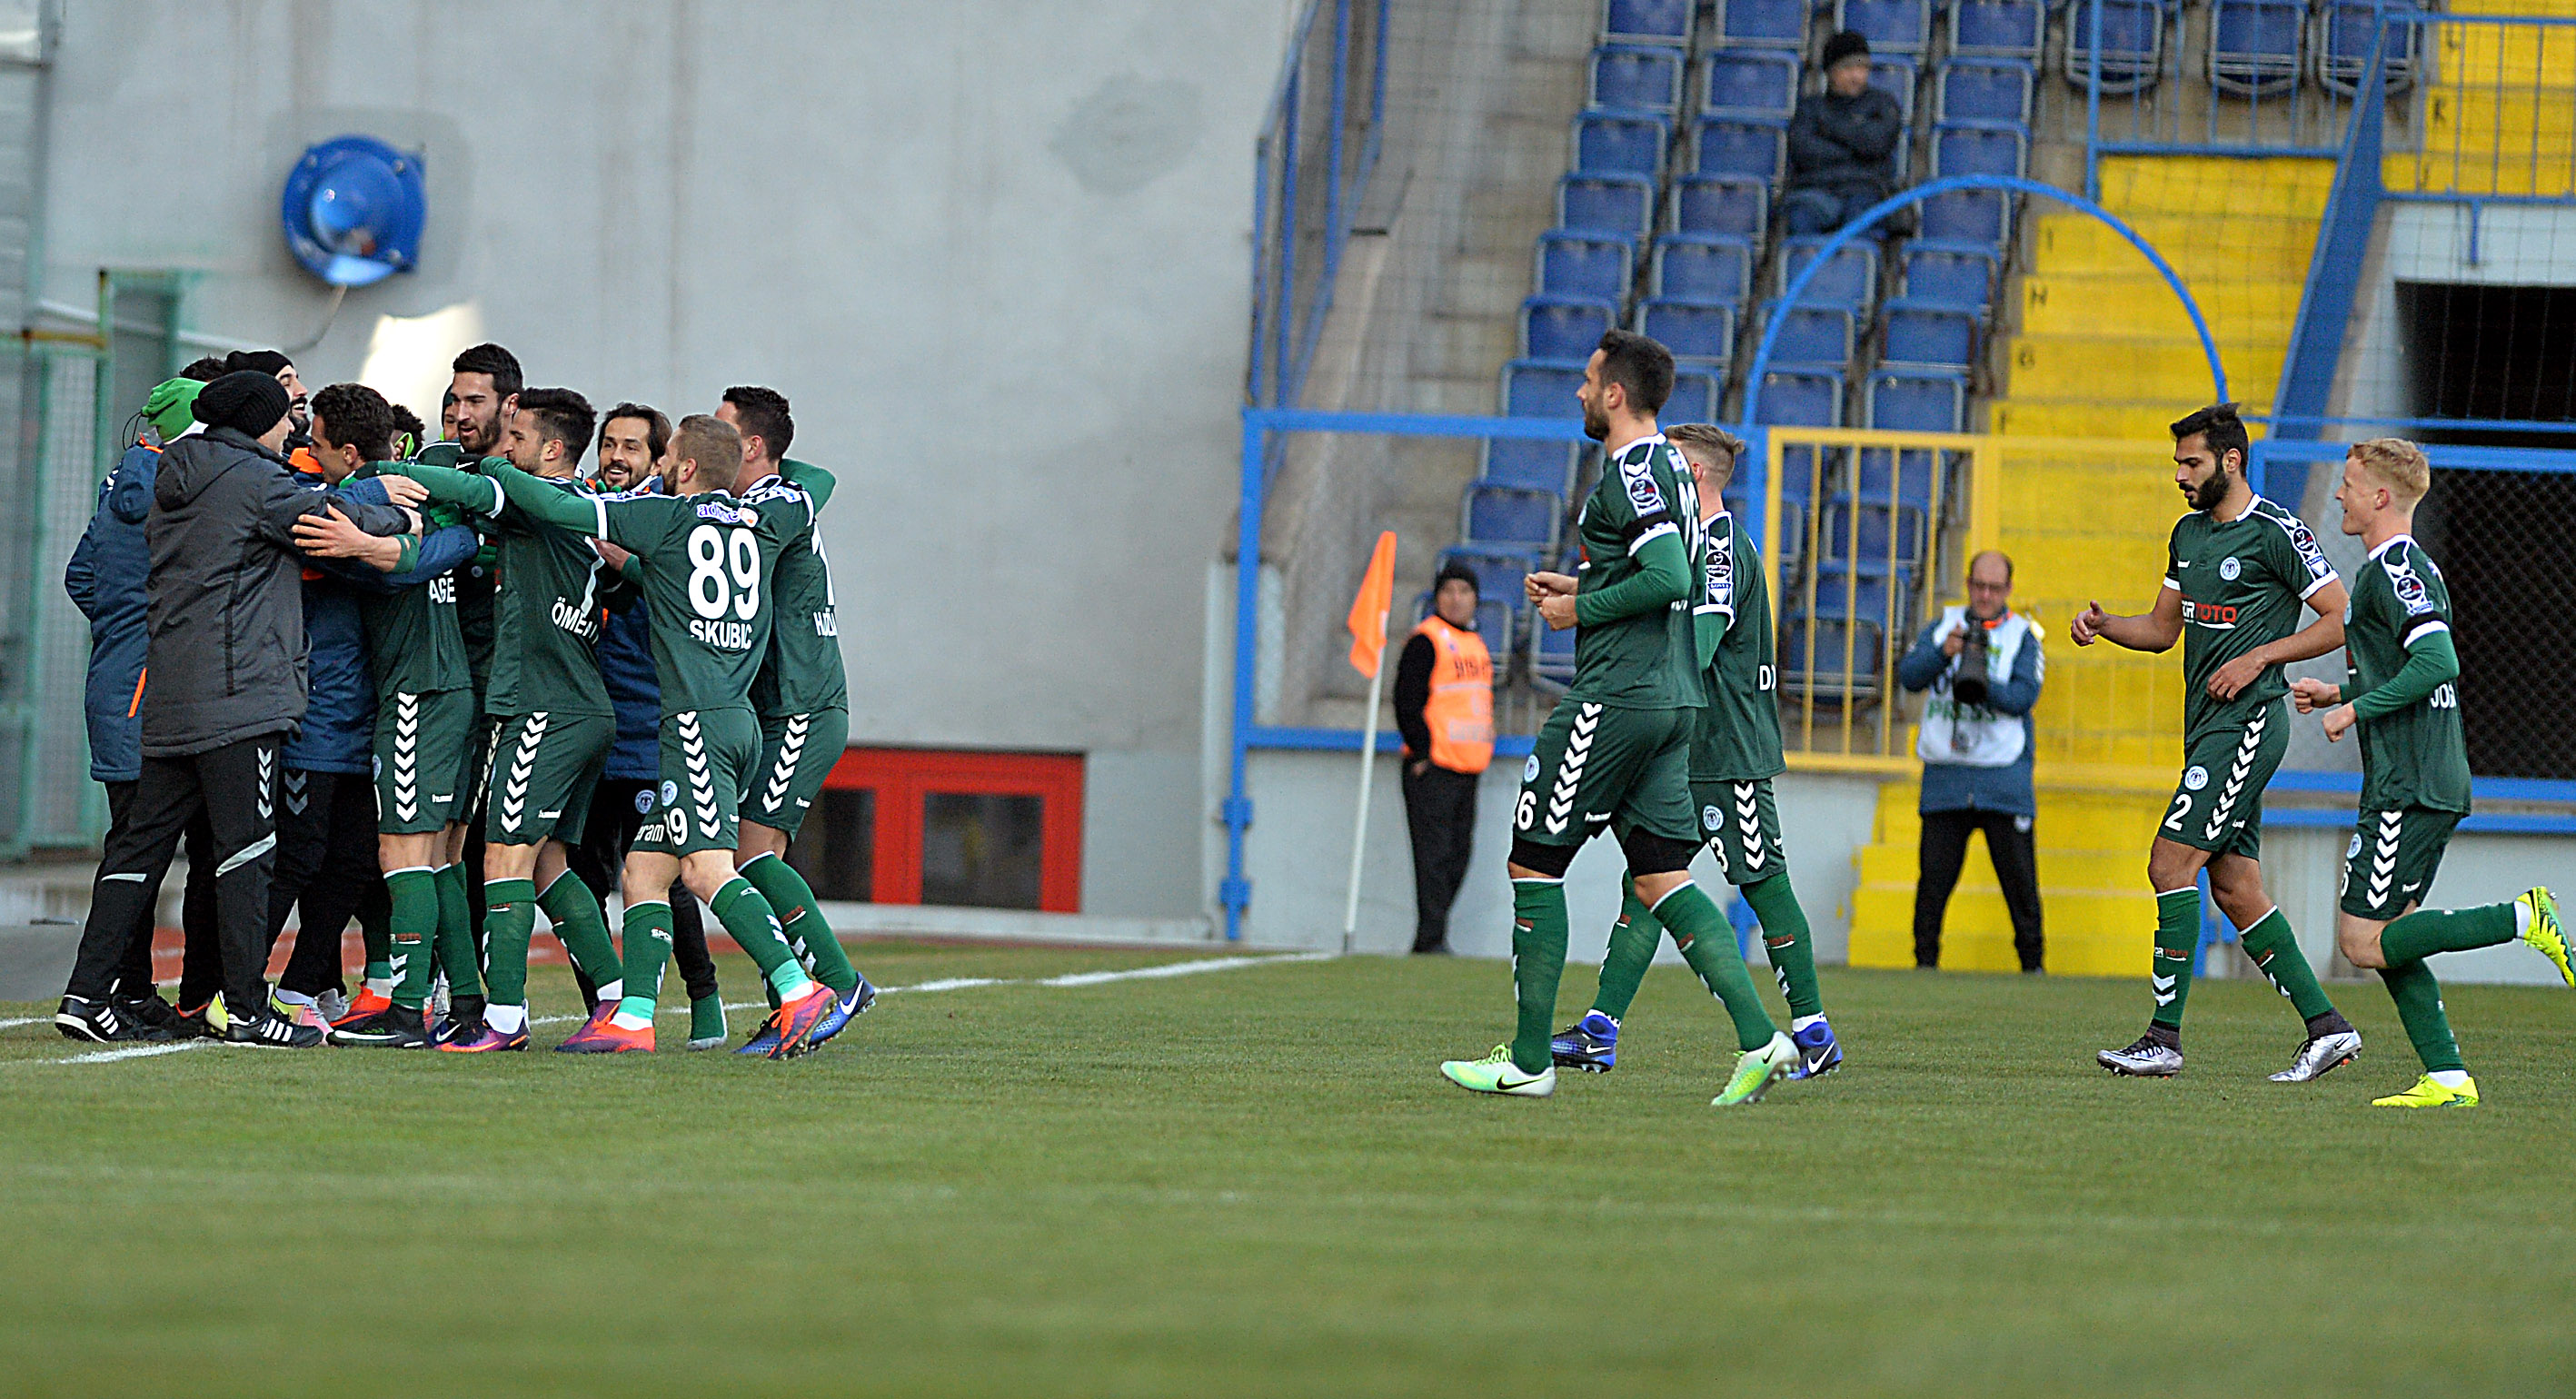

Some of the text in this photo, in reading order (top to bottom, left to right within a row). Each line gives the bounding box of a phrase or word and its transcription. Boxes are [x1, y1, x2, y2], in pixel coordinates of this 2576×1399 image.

[688, 524, 761, 620] 89
[689, 619, 753, 650] SKUBIC
[2164, 793, 2193, 832] 2
[1710, 836, 1729, 873] 3
